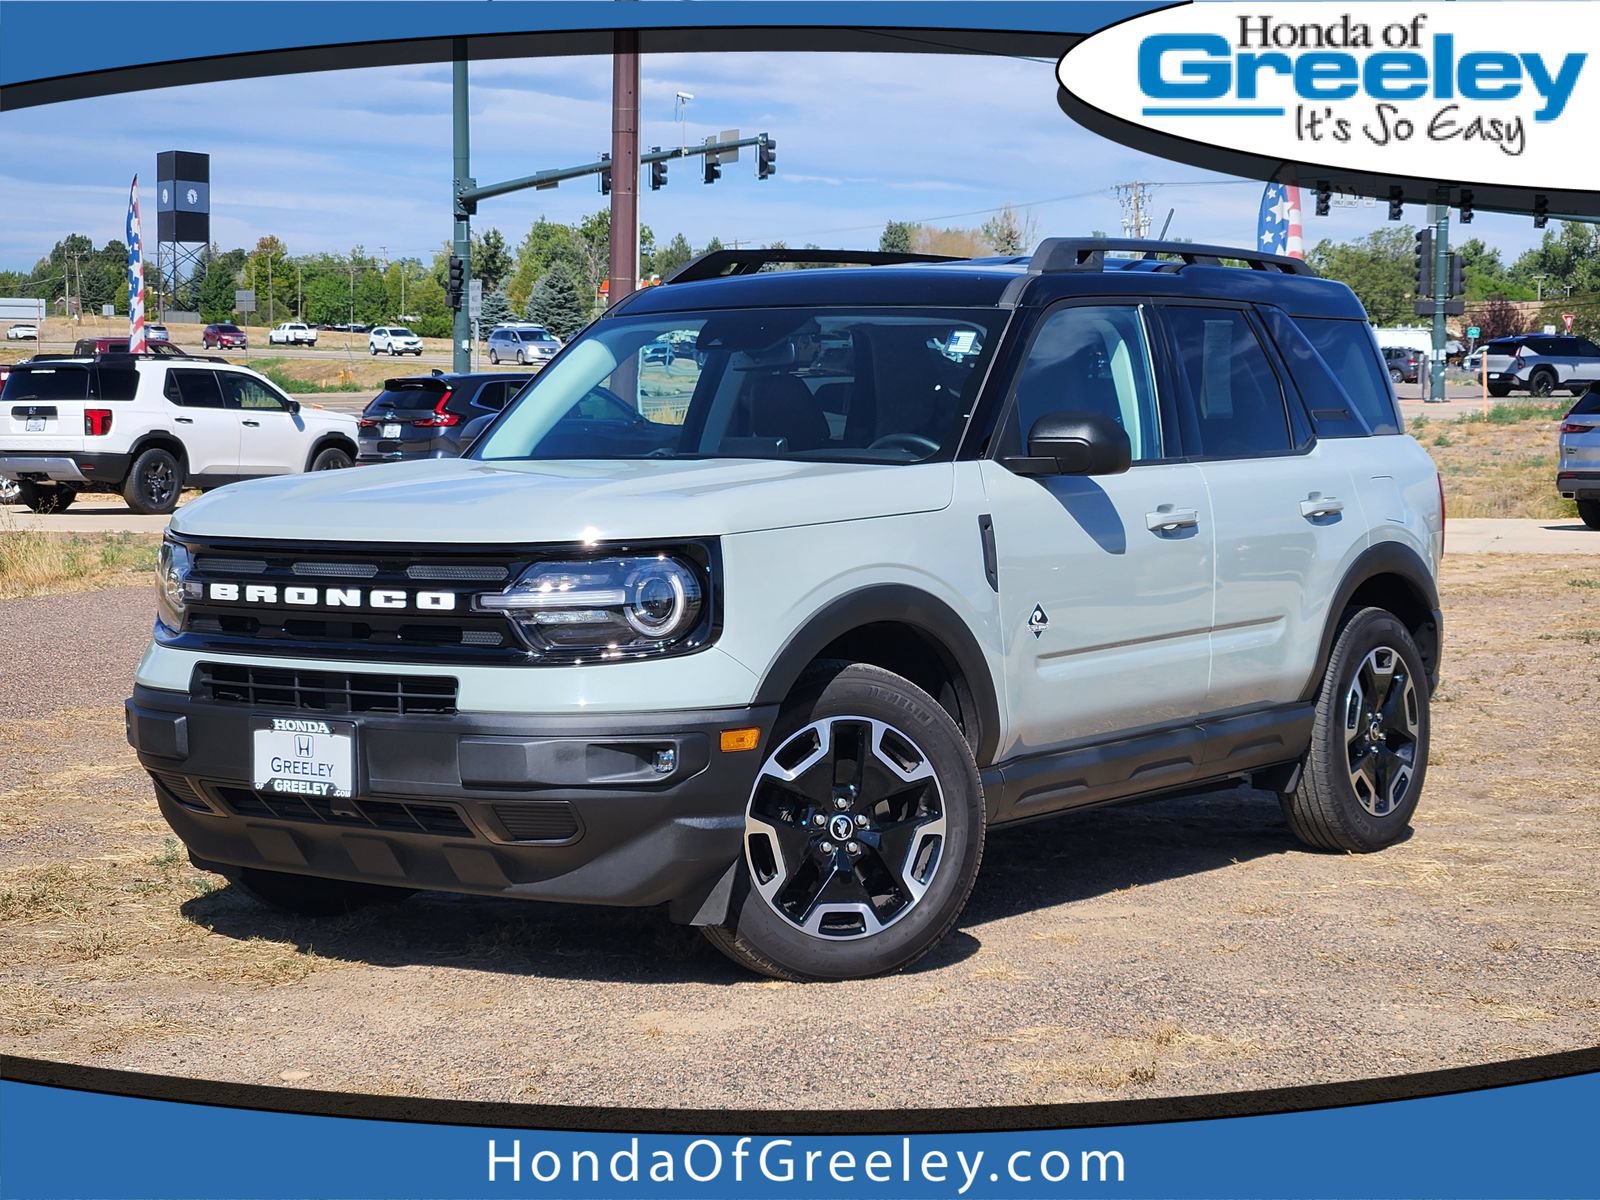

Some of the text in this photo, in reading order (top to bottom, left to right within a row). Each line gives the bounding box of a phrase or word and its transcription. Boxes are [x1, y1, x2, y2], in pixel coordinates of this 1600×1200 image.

[209, 583, 457, 611] BRONCO
[272, 719, 331, 733] HONDA
[271, 757, 334, 777] GREELEY
[255, 782, 264, 790] OF
[274, 779, 329, 795] GREELEY
